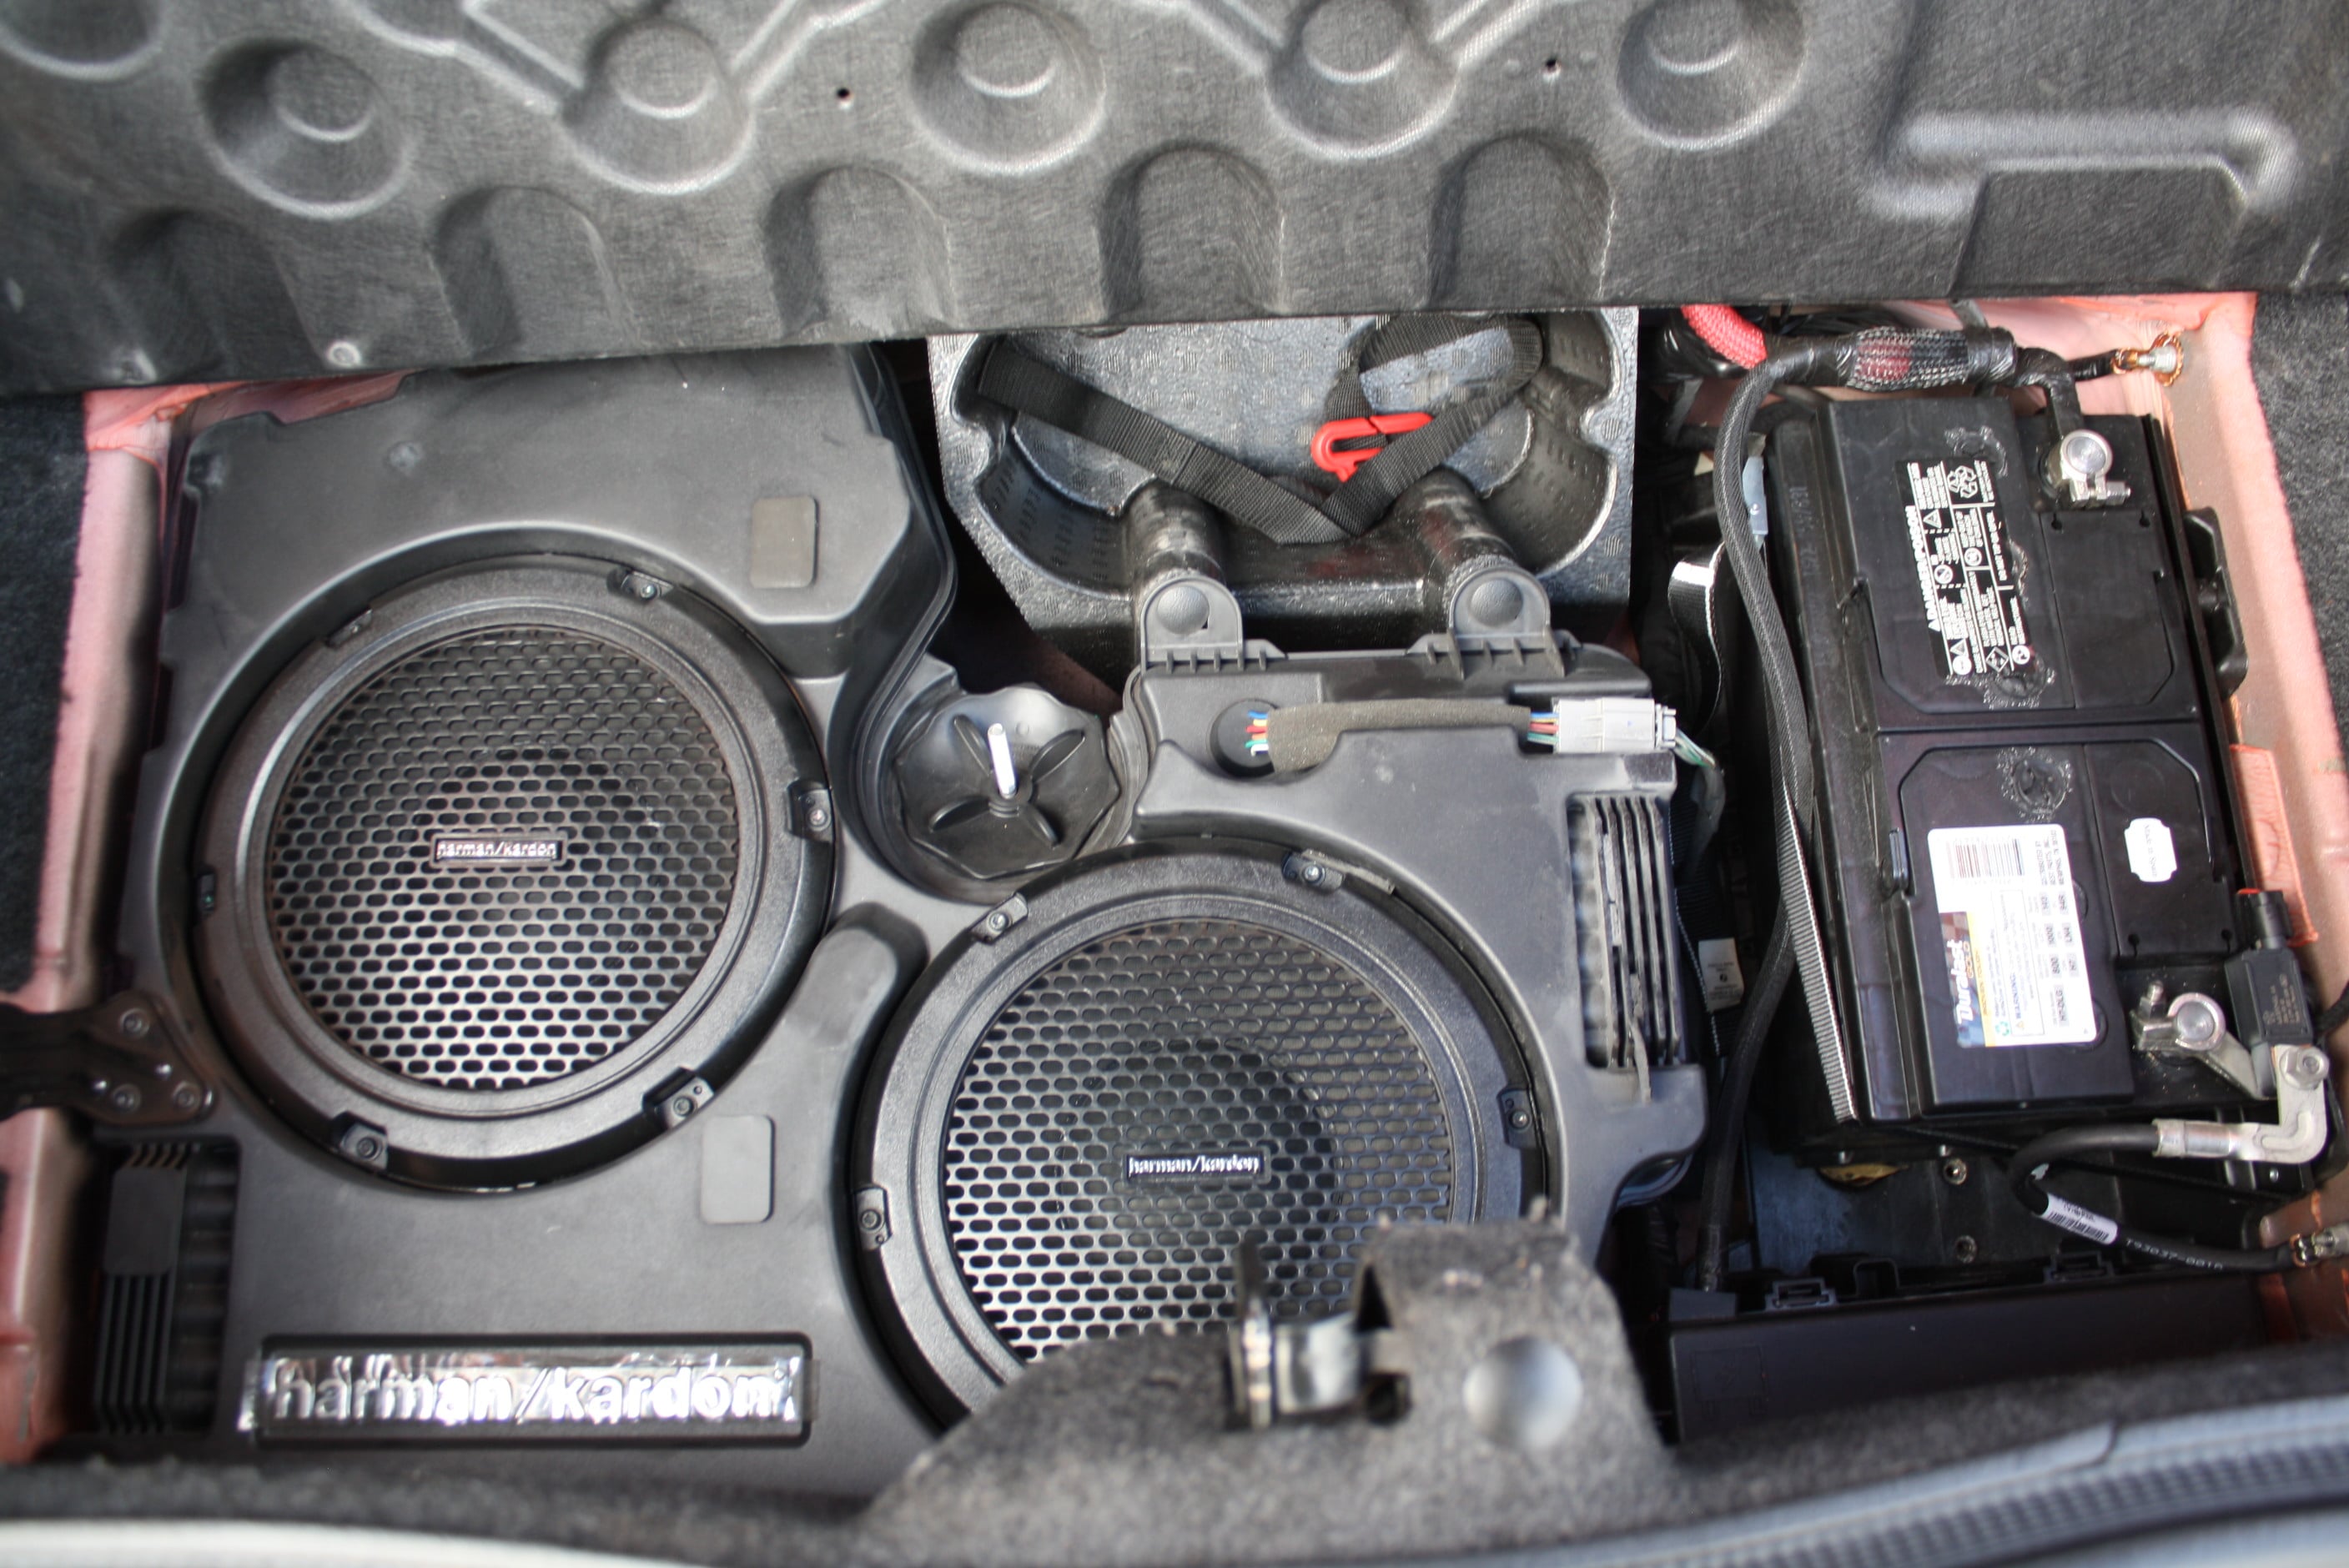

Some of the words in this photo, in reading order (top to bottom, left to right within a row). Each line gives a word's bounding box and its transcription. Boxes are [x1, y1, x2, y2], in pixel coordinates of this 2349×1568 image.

[1947, 938, 1974, 1024] Duralast
[2050, 957, 2060, 975] 800
[1128, 1153, 1260, 1177] harman/kardon
[271, 1361, 784, 1425] harman/kardon
